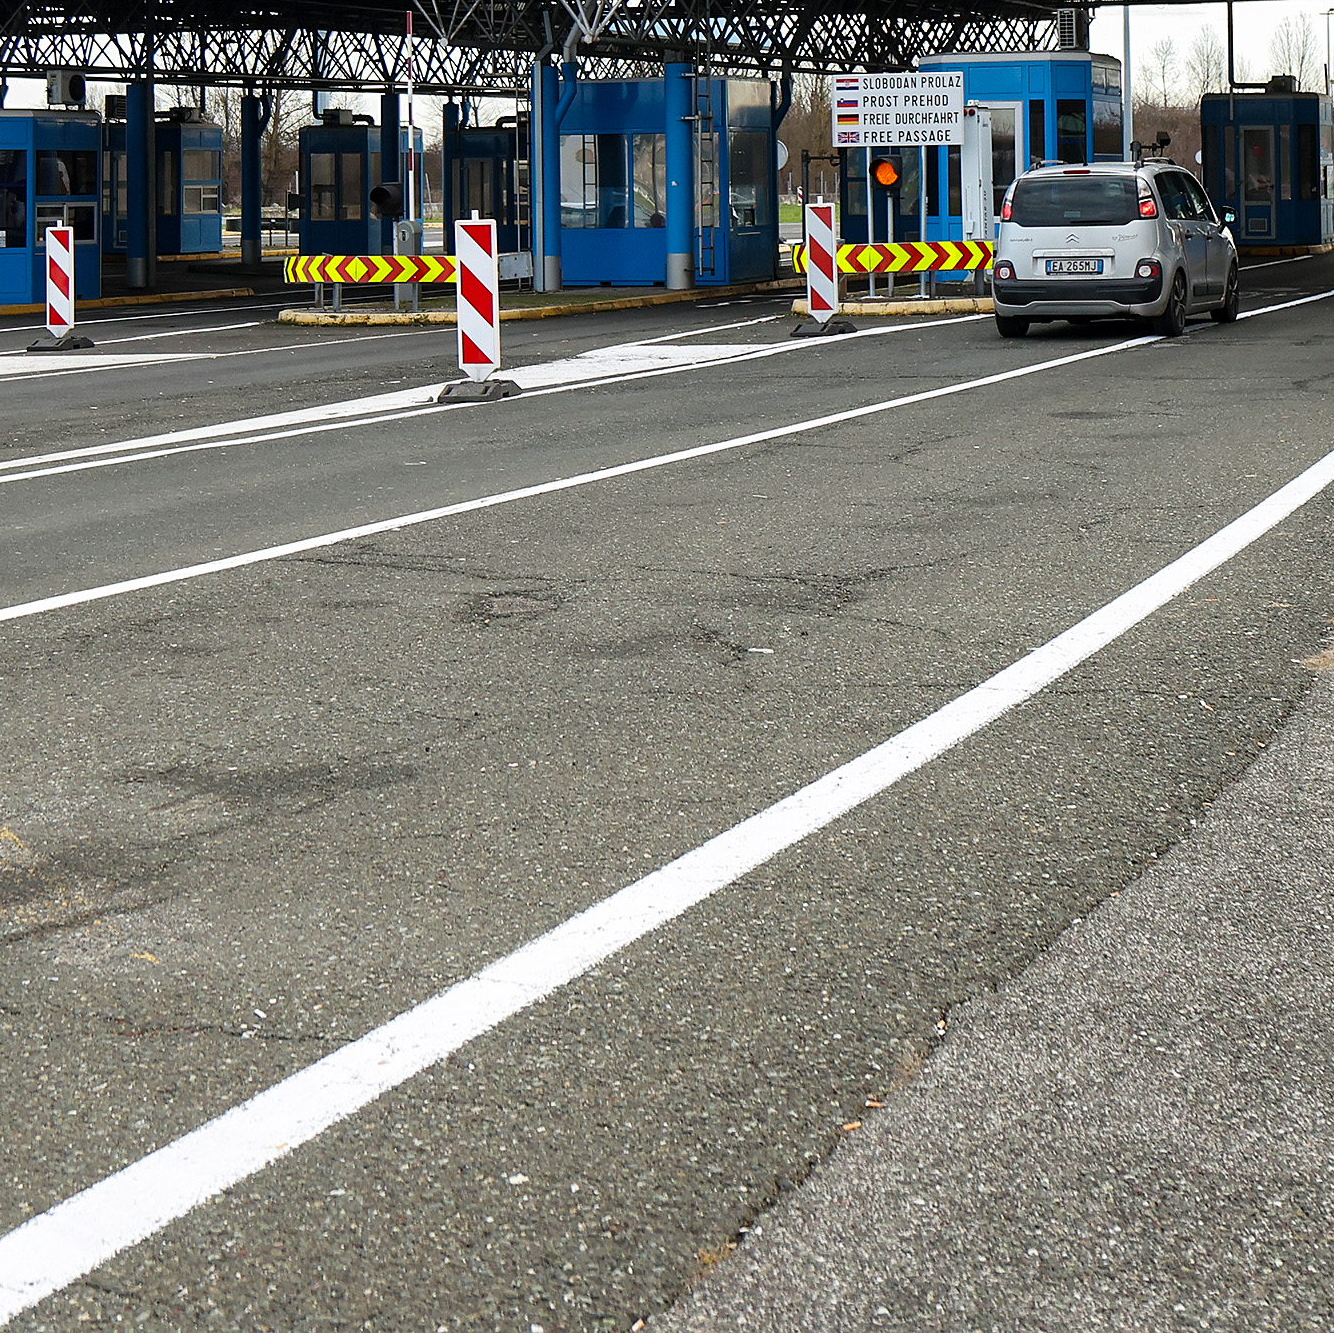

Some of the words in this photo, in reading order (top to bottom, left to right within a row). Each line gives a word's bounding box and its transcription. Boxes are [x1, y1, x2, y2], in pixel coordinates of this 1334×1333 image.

[862, 77, 917, 90] SLOBODAN
[921, 76, 961, 88] PROLAZ
[863, 95, 899, 108] PROST
[904, 94, 949, 107] PREHOD
[863, 113, 890, 125] FREIE
[895, 112, 959, 125] DURCHFAHRT
[864, 131, 893, 143] FREE
[898, 130, 951, 142] PASSAGE
[1052, 261, 1064, 272] EA
[1066, 260, 1097, 271] 265MJ
